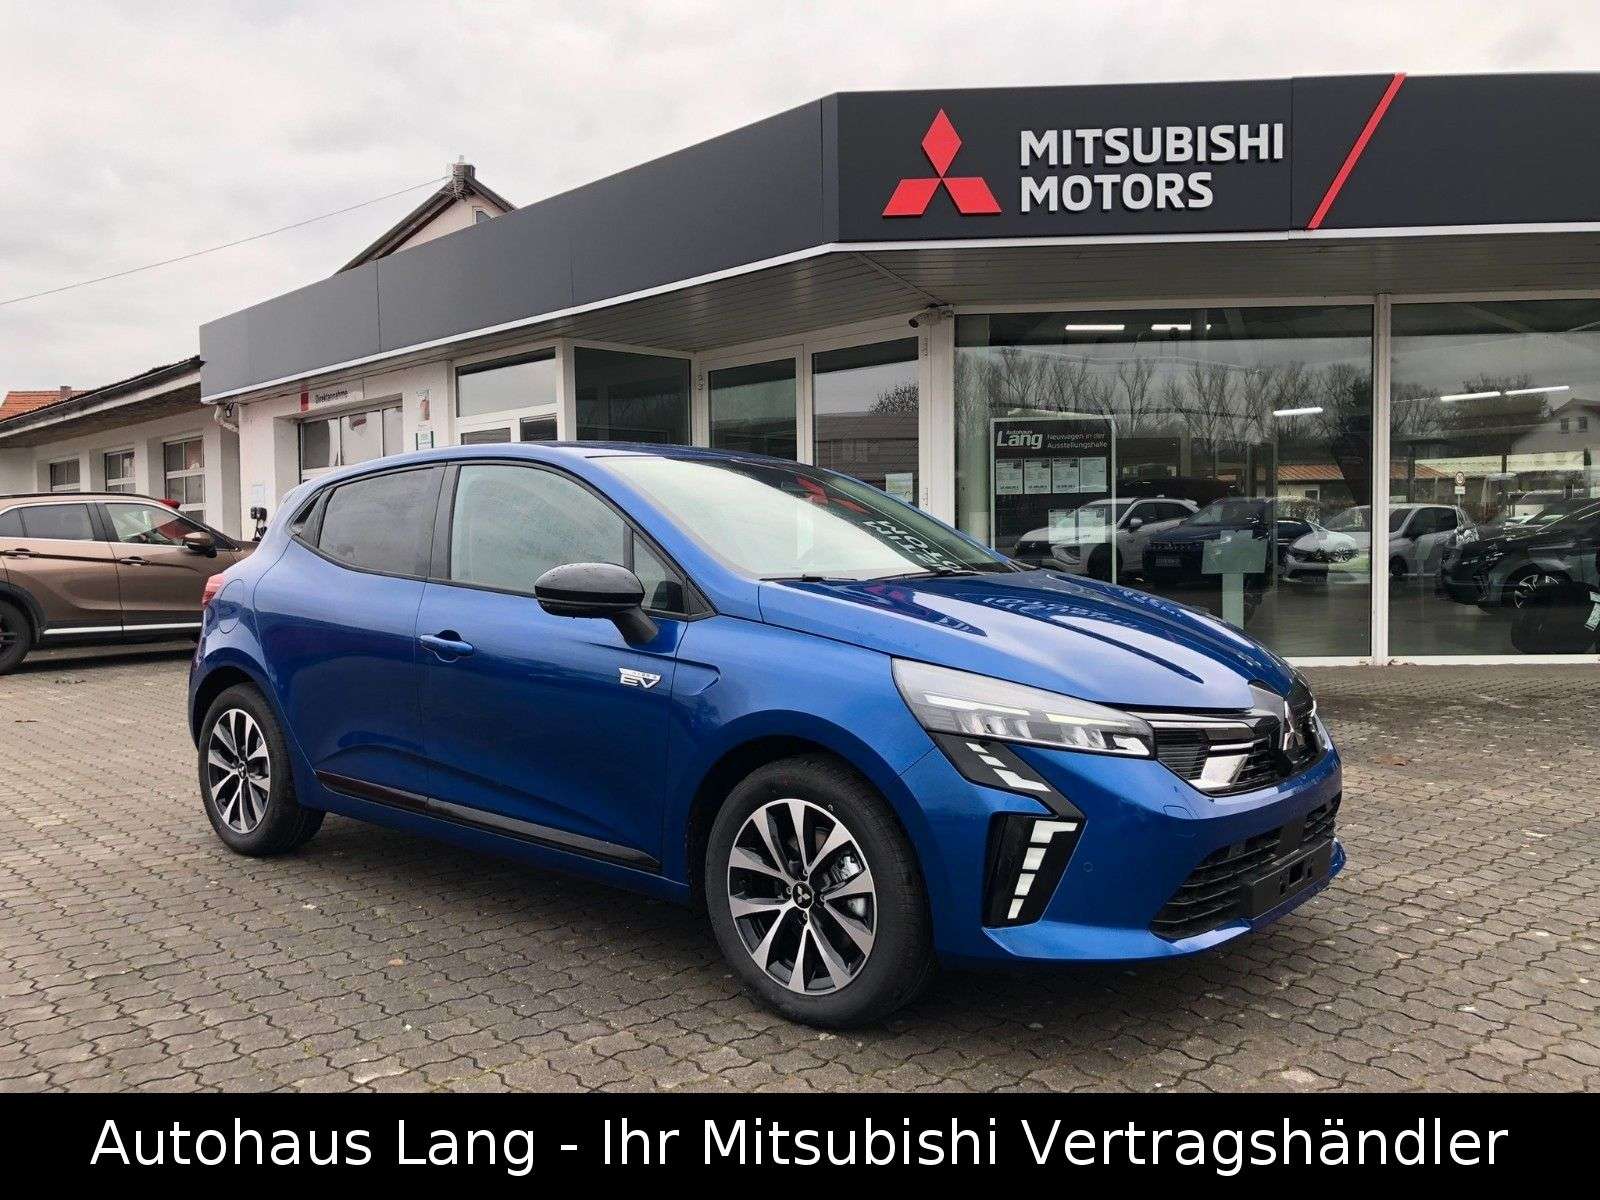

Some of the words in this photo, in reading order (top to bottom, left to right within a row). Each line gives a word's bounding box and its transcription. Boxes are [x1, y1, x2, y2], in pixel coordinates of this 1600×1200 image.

[1020, 123, 1284, 166] MITSUBISHI
[1020, 171, 1214, 212] MOTORS
[996, 430, 1043, 449] Lang
